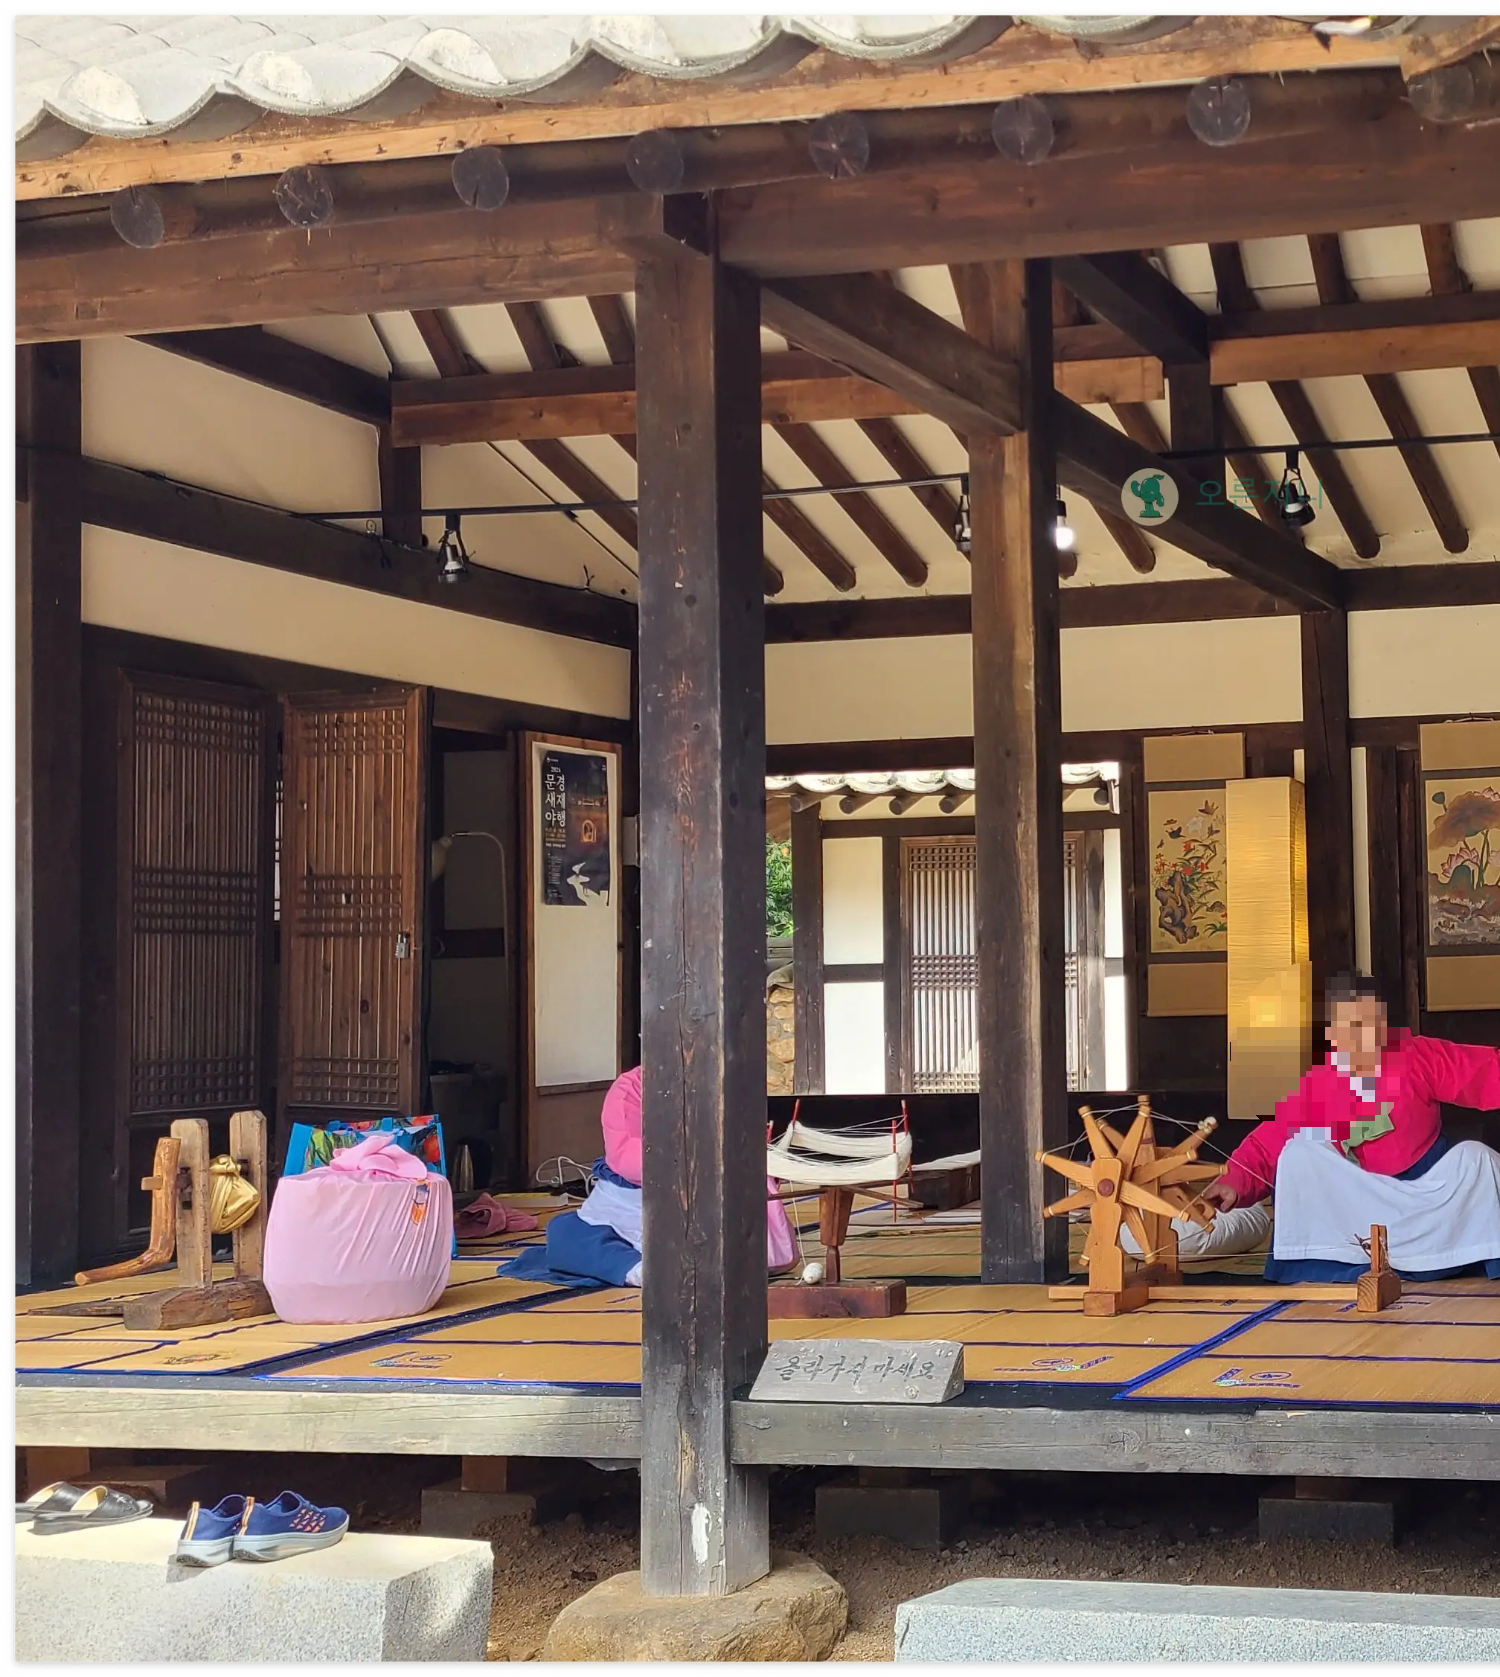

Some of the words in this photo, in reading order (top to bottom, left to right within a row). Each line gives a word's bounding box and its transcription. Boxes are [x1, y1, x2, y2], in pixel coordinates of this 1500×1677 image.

[544, 774, 565, 792] 문경
[545, 791, 566, 810] 새재
[545, 809, 566, 827] 야행
[873, 1355, 935, 1383] 마세요
